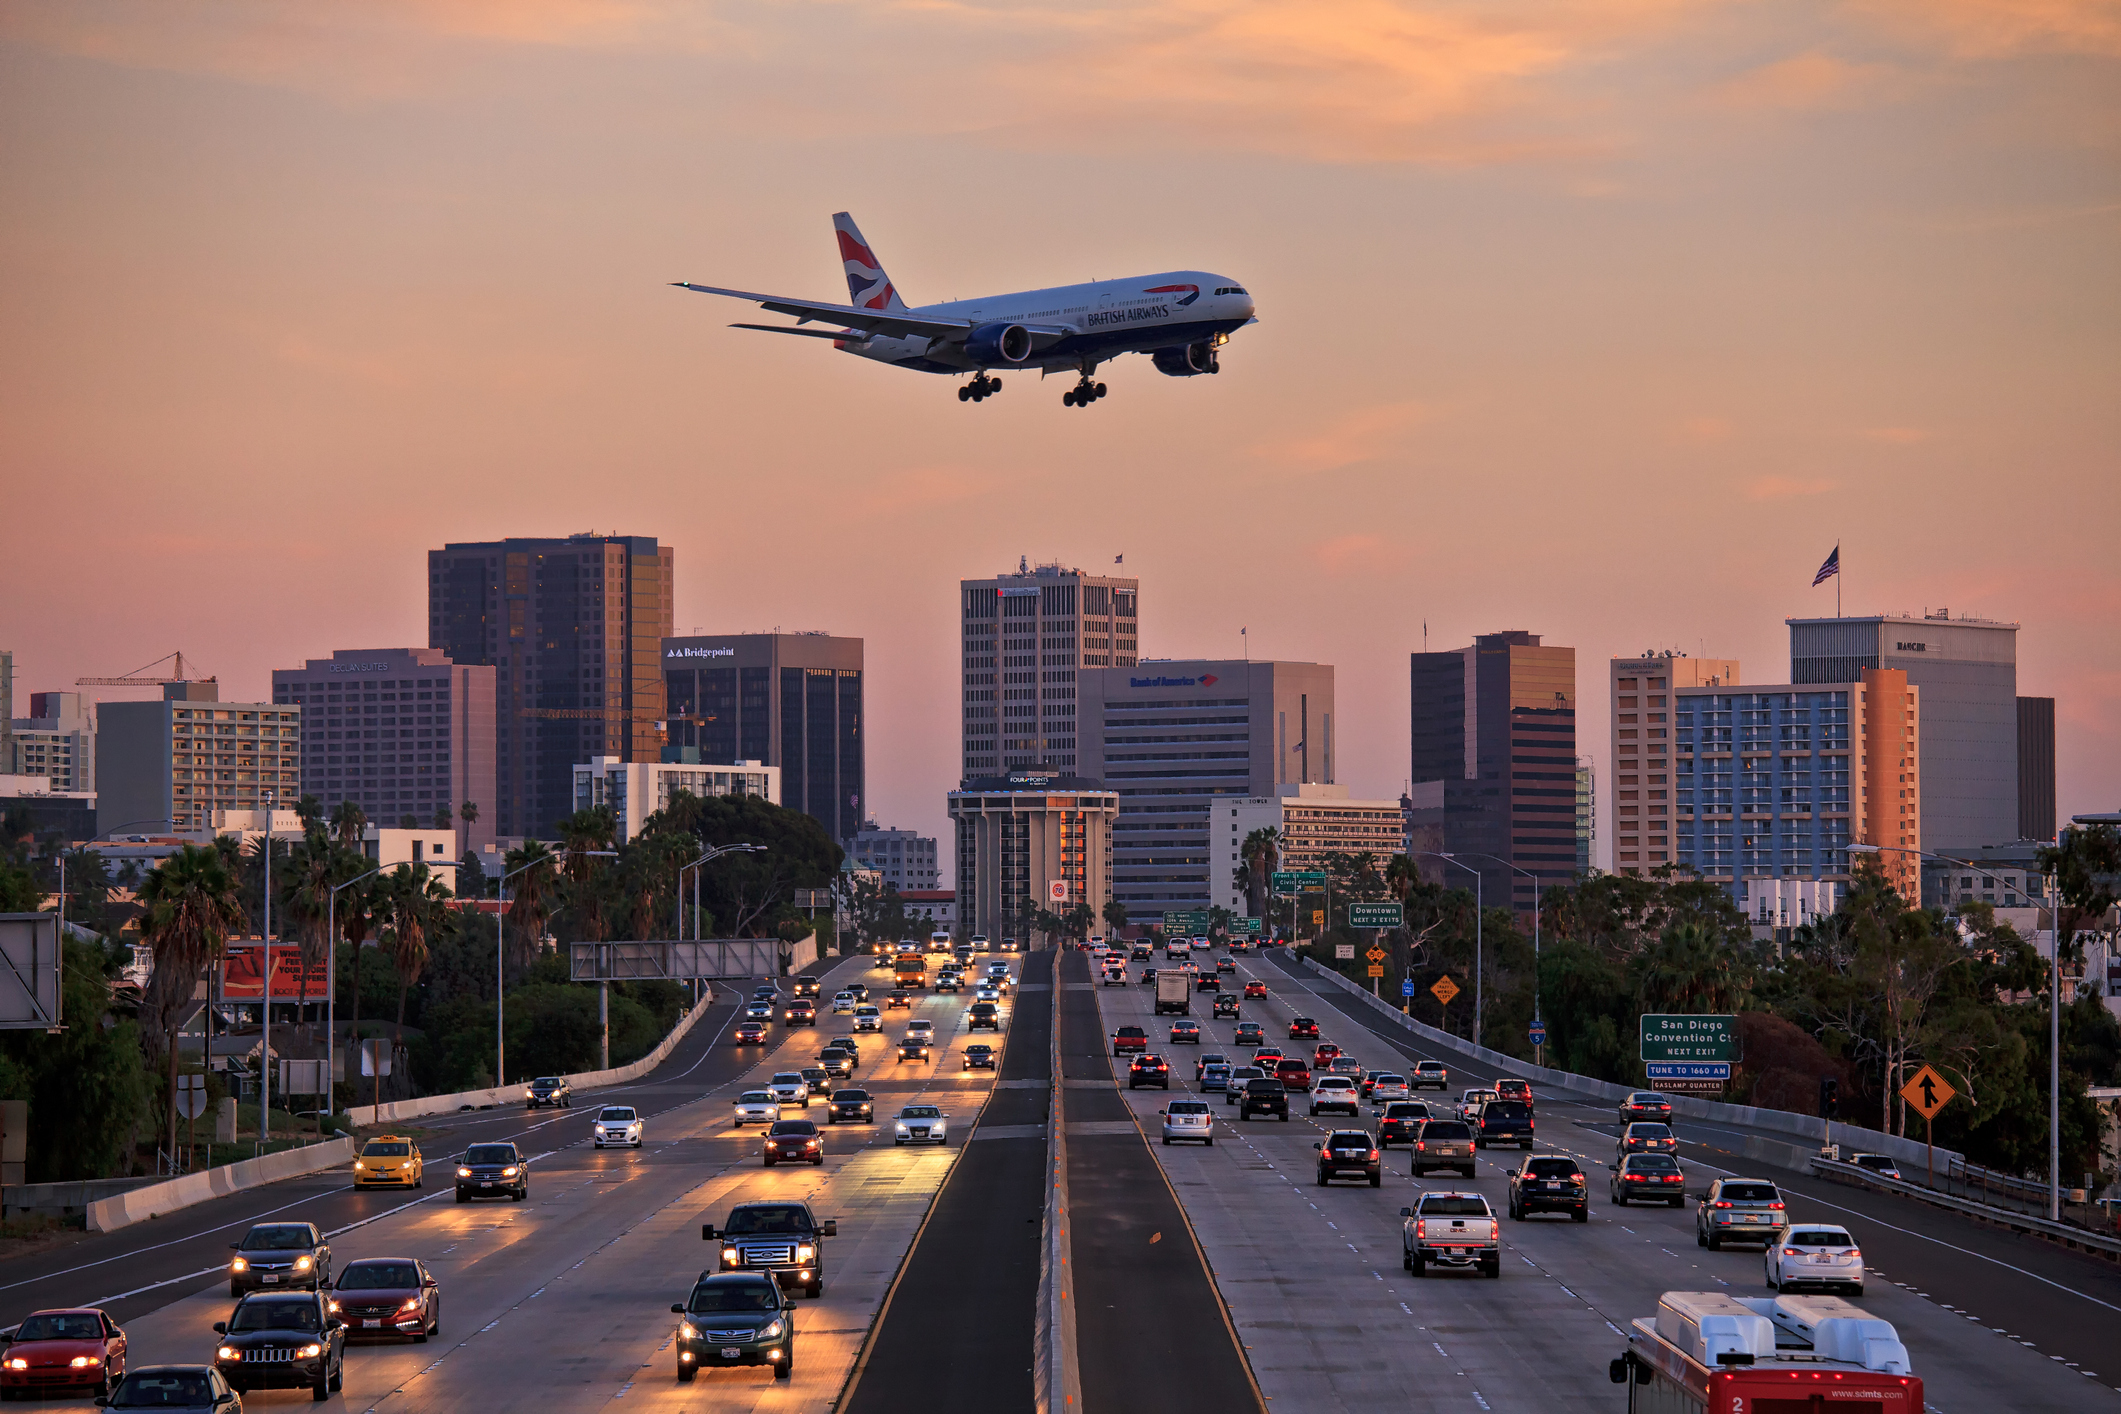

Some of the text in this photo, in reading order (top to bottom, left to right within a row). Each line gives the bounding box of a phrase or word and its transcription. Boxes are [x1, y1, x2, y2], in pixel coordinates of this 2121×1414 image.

[1088, 304, 1169, 326] BRITISH AIRWAYS
[684, 646, 734, 659] Bridgepoint
[330, 662, 388, 672] DECLAN SUITES
[1130, 676, 1196, 688] Bank of America
[1662, 1020, 1723, 1032] San Diego
[1646, 1033, 1713, 1042] Convention
[1832, 1389, 1903, 1398] www.sdmts.com
